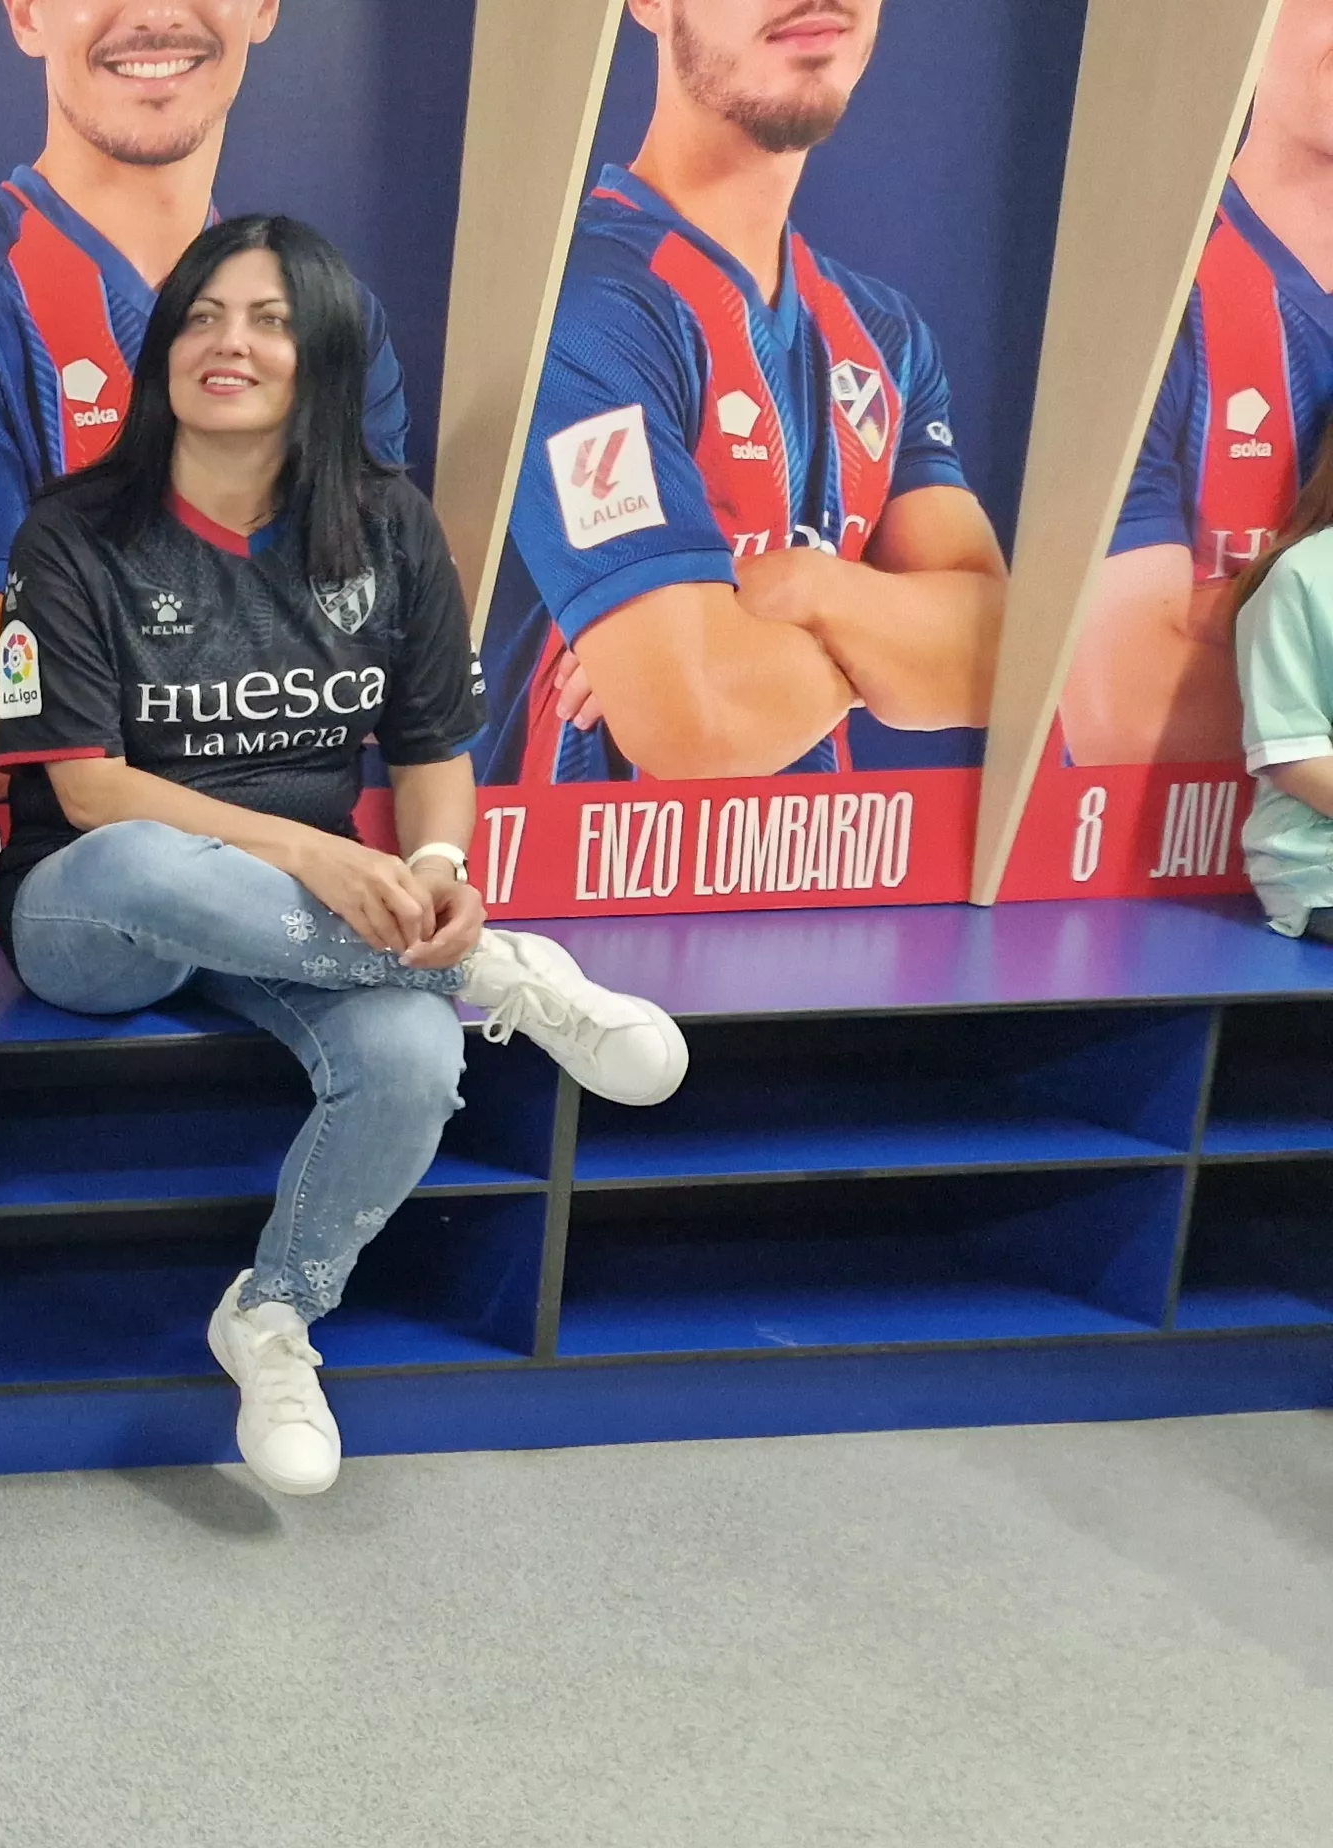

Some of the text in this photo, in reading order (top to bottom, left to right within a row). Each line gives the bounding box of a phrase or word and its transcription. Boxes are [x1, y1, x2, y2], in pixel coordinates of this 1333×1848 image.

[73, 405, 118, 427] soka
[731, 441, 768, 460] soka
[1229, 438, 1272, 458] soka
[579, 495, 649, 530] LALIGA
[141, 624, 195, 636] KELME
[1072, 781, 1238, 882] 8 JAVI
[483, 791, 914, 904] 17 ENZO LOMBARDO
